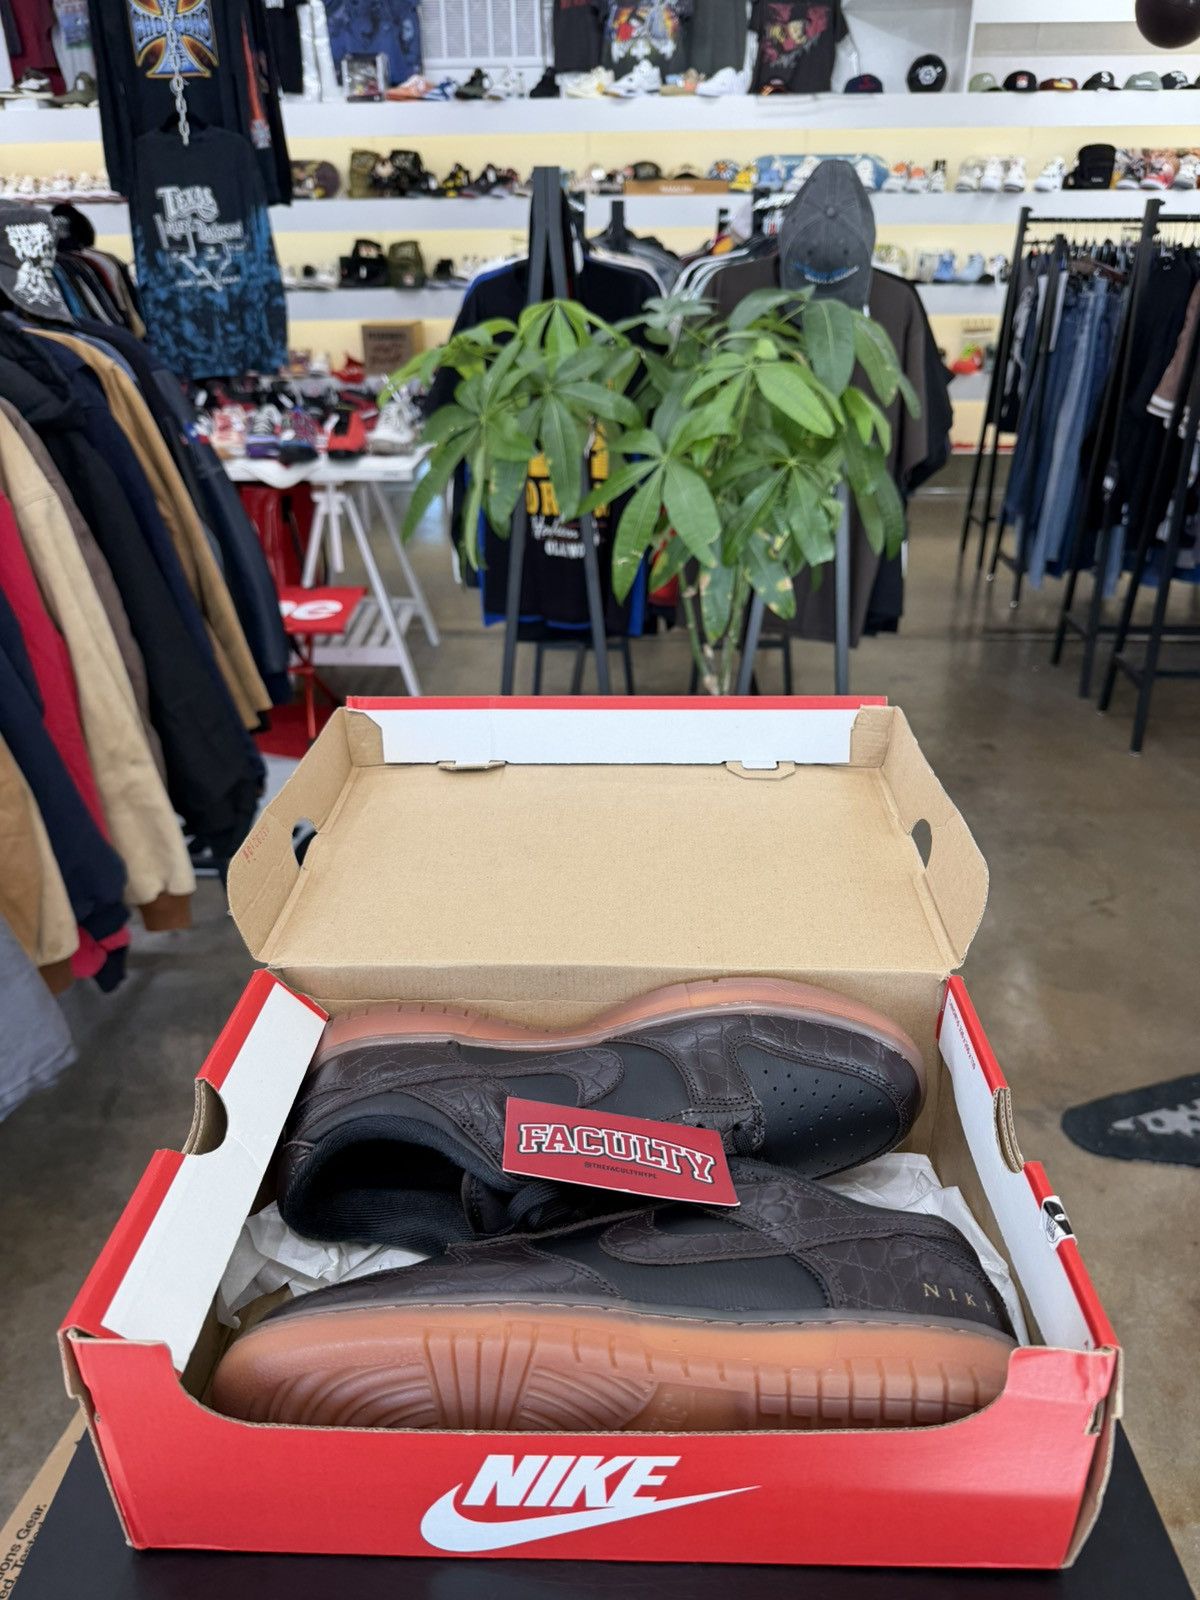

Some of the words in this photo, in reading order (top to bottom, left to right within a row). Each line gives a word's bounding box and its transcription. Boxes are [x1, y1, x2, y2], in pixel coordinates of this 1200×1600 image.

[518, 1123, 716, 1185] FACULTY
[461, 1454, 682, 1508] NIKE
[16, 1504, 47, 1540] Gear.
